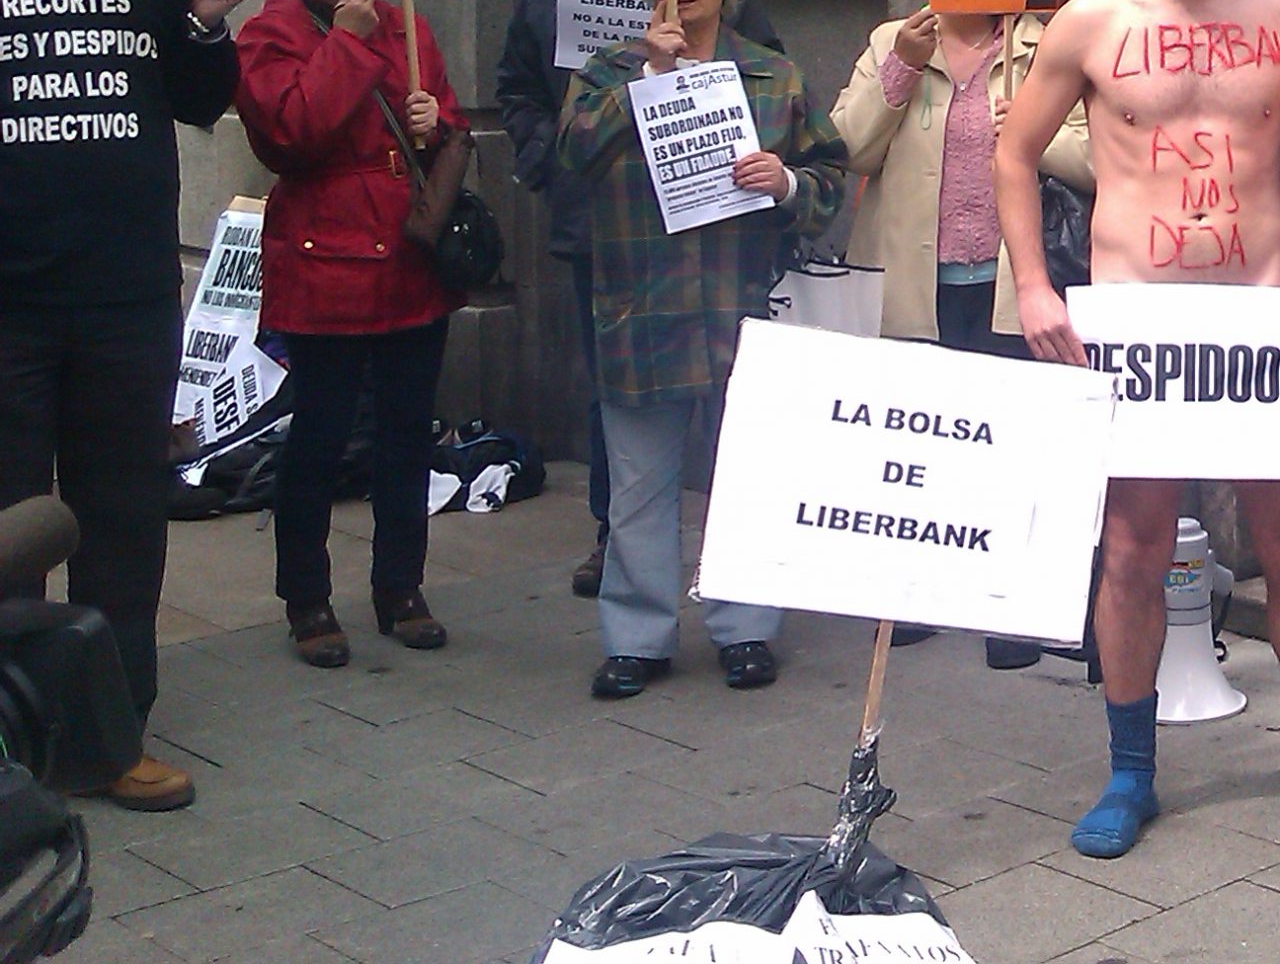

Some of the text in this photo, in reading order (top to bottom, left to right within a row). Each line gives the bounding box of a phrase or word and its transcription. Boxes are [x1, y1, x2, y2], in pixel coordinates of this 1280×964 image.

[573, 13, 592, 23] NO
[595, 16, 604, 25] A
[608, 17, 624, 28] LA
[582, 29, 600, 39] DE
[603, 32, 620, 42] LA
[33, 32, 50, 58] Y
[12, 71, 130, 102] PARA LOS
[642, 96, 697, 122] LA DEUDA
[647, 105, 744, 142] SUBORDINADA NO
[2, 112, 140, 144] DIRECTIVOS
[653, 145, 668, 162] ES
[668, 140, 686, 158] UN
[686, 131, 720, 153] PLAZO
[1152, 124, 1234, 174] ASI
[659, 148, 733, 181] ES UN FRAUDE
[1181, 177, 1240, 214] NOS
[1150, 214, 1247, 270] DEJA
[831, 399, 994, 445] LA BOLSA
[882, 461, 927, 488] DE
[795, 502, 993, 553] LIBERBANK
